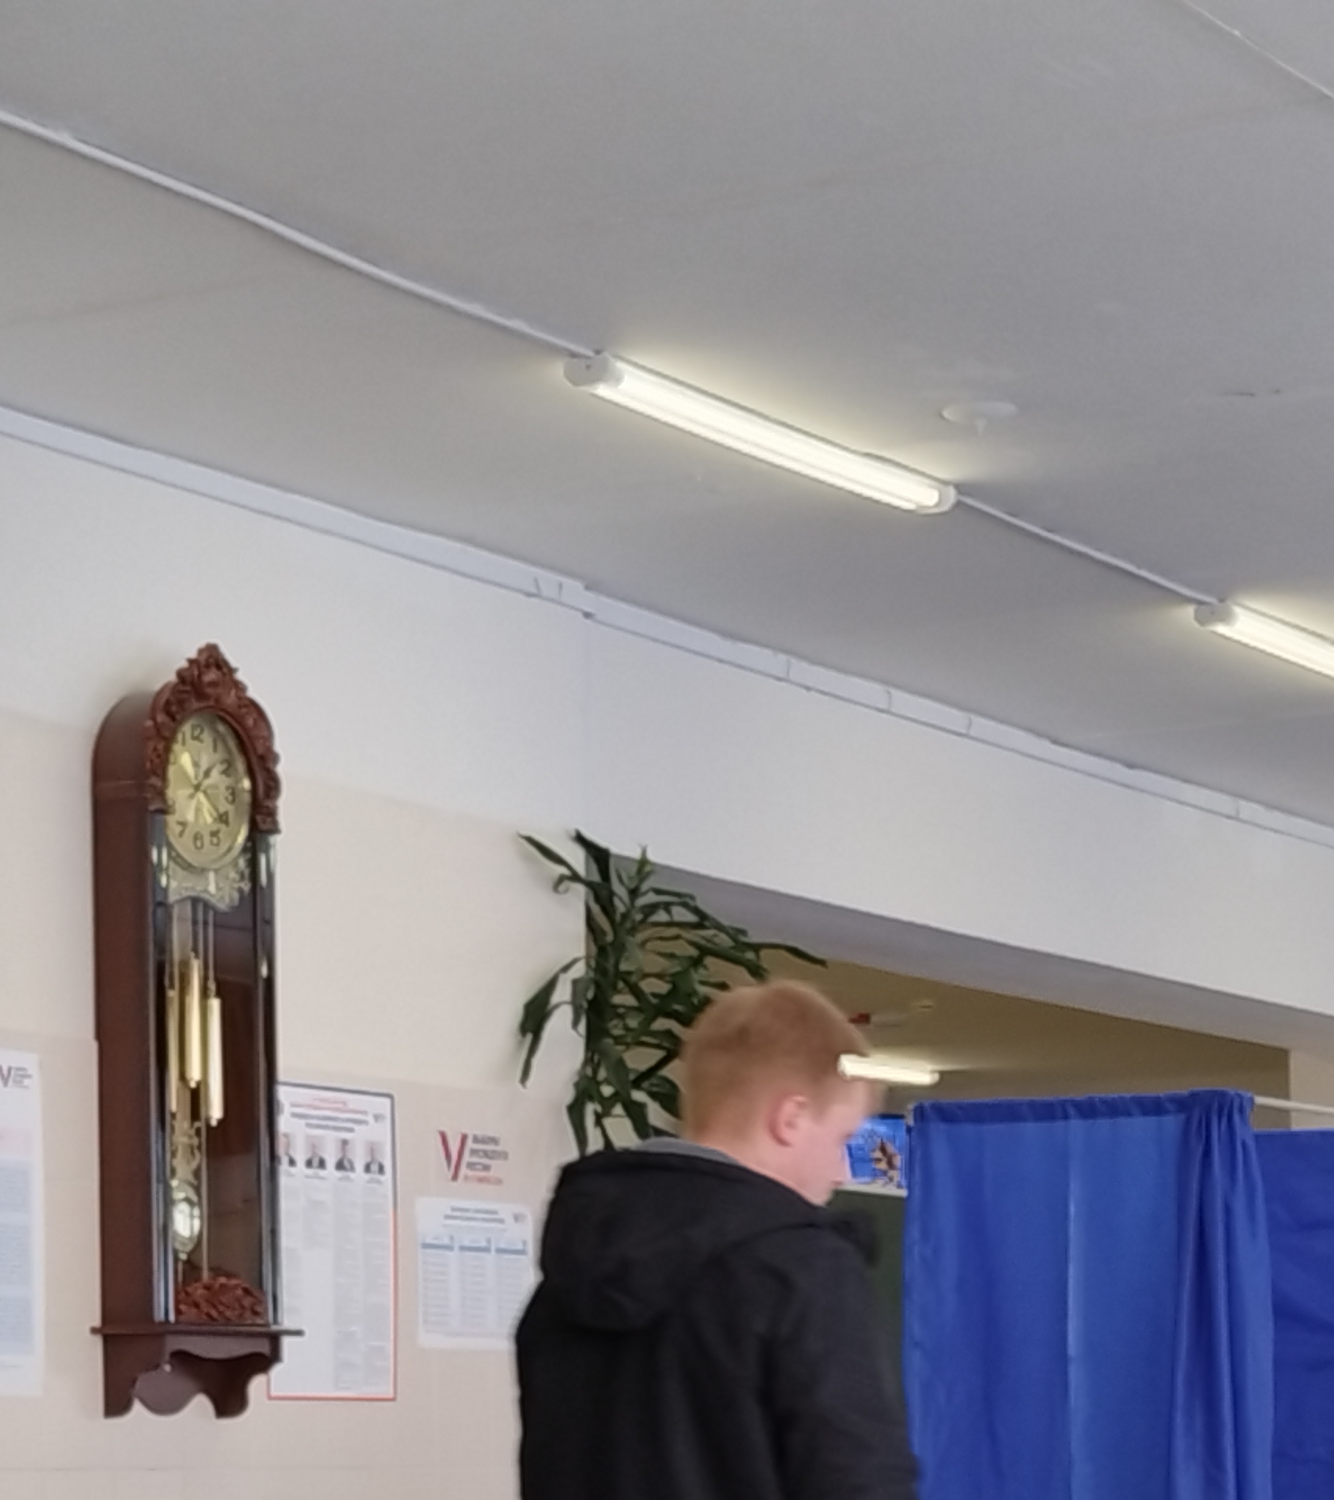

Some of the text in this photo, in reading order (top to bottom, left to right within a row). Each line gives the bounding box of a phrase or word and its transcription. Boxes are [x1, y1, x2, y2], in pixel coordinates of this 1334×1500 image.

[191, 723, 205, 743] 12
[219, 759, 232, 778] 2
[224, 786, 237, 805] 3
[217, 811, 230, 828] 4
[176, 821, 188, 838] 7
[209, 828, 221, 848] 5
[193, 831, 204, 851] 6
